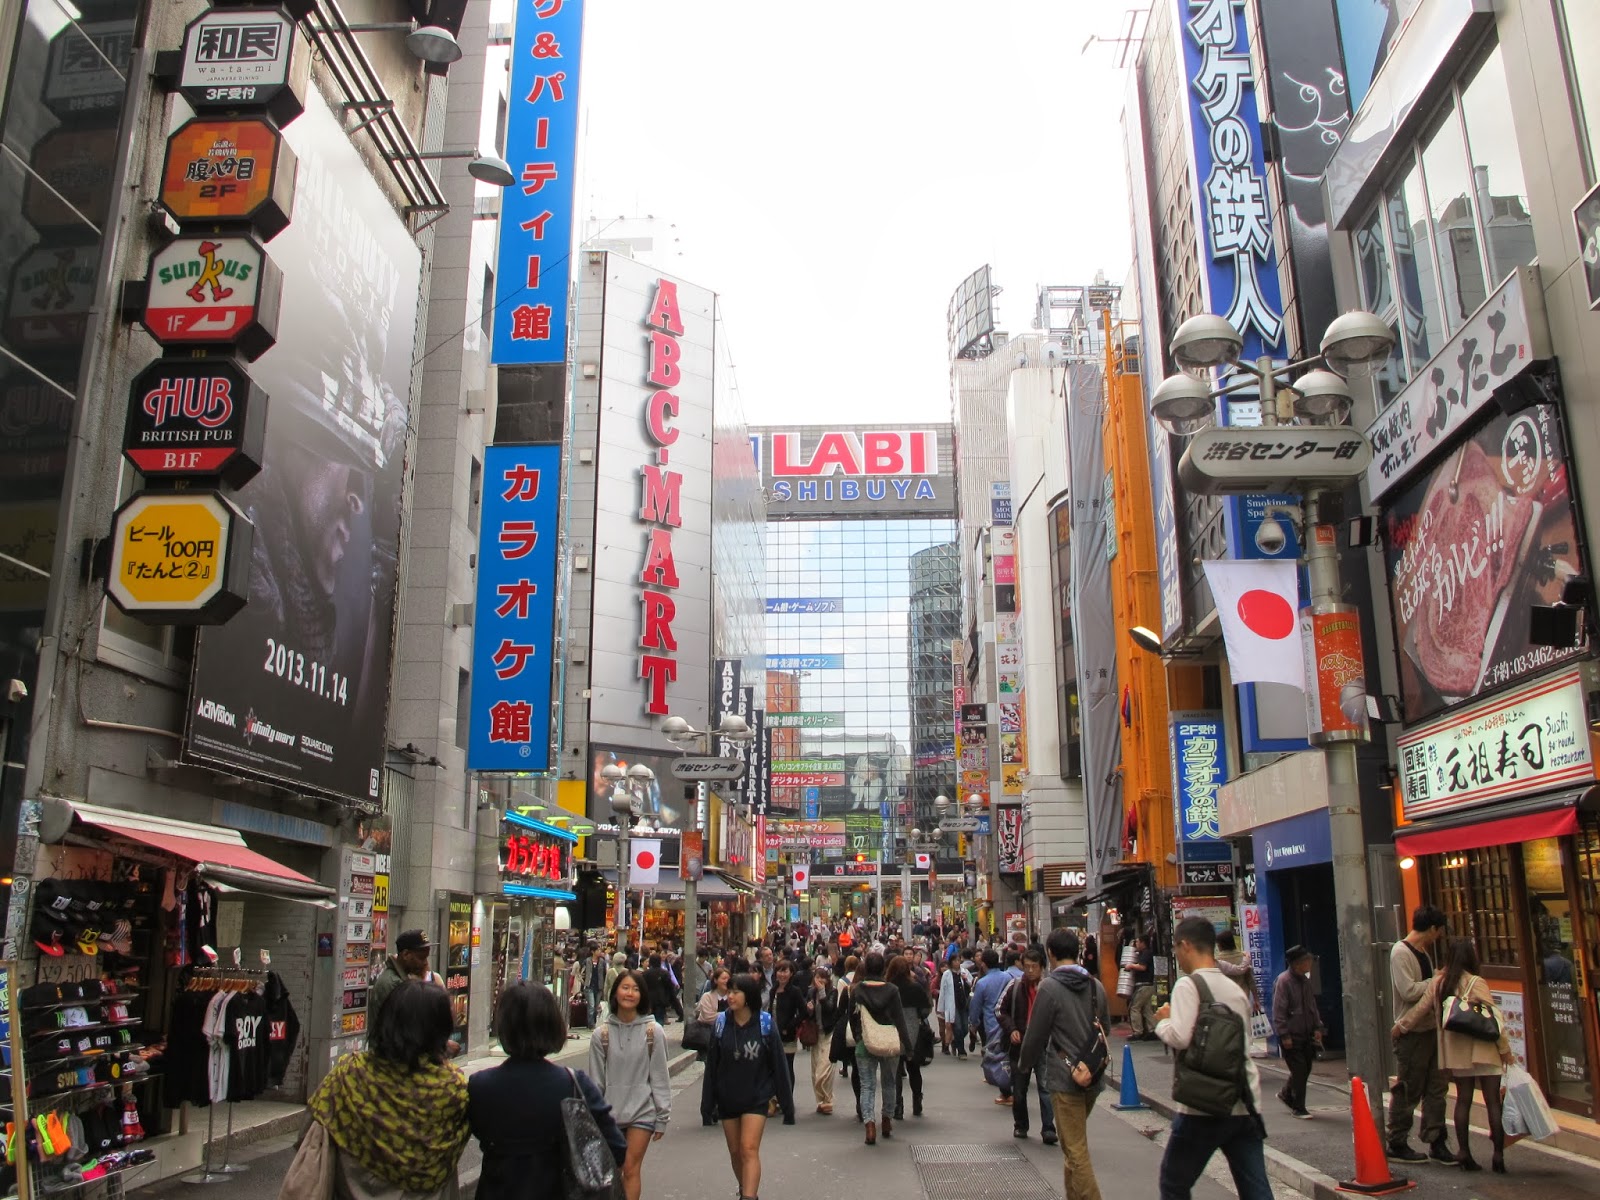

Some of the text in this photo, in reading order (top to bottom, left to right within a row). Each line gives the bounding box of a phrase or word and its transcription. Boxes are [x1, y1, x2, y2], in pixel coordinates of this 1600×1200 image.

[200, 27, 278, 60] 和民
[206, 87, 257, 100] 3F受付
[184, 156, 256, 182] 腹八分目
[199, 184, 237, 198] 2F
[166, 314, 186, 332] 1F
[1425, 293, 1518, 440] ふたご
[142, 376, 234, 428] HUB
[141, 429, 234, 443] BRITISH PUB
[162, 452, 202, 470] B1F
[772, 431, 939, 477] LABI
[1203, 440, 1363, 461] 渋谷センター街
[1380, 431, 1423, 479] ホルモン
[773, 478, 936, 501] SHIBUYA
[1246, 499, 1288, 508] Smoking
[1247, 509, 1265, 519] Spa
[129, 525, 175, 542] ビール
[163, 539, 214, 558] 100円
[488, 463, 541, 744] カラオケ館
[264, 638, 348, 706] 2013.11.14
[1180, 724, 1217, 736] 2F受付
[1546, 711, 1569, 736] Sushi
[675, 763, 739, 772] 渋谷センター街
[1445, 722, 1543, 793] 元祖寿司
[1550, 748, 1585, 767] restaurant
[771, 776, 836, 784] デジタルレコーダー
[1182, 736, 1221, 840] カラオケの鉄人
[1218, 863, 1231, 874] B1
[374, 885, 387, 907] AR
[236, 1015, 262, 1040] BOY
